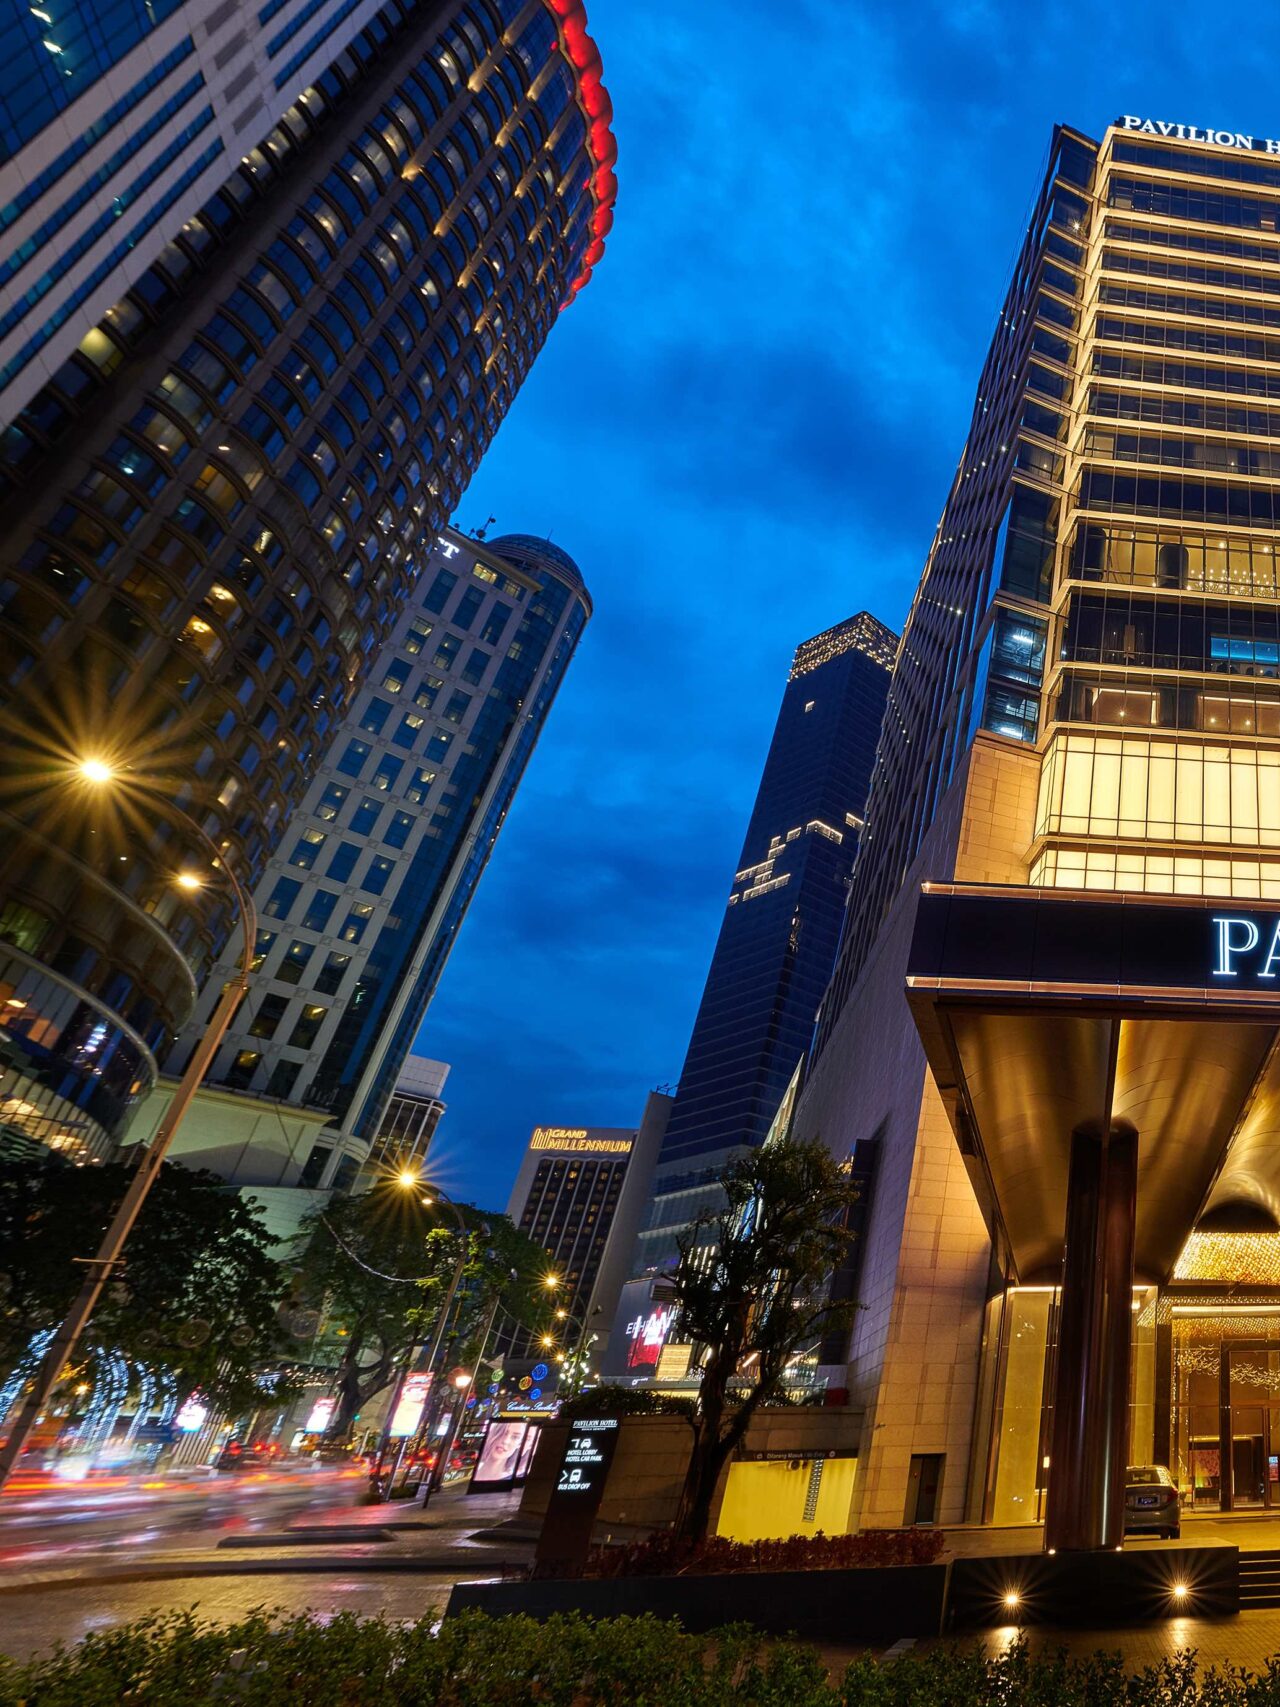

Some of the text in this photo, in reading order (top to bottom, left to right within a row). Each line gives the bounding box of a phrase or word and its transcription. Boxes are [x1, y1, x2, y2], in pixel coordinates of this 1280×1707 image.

[1123, 114, 1254, 150] PAVILION
[551, 1129, 588, 1139] GRAND
[546, 1138, 633, 1153] MILLENNIUM
[600, 1419, 618, 1427] HOTEL
[580, 1482, 591, 1490] OFF
